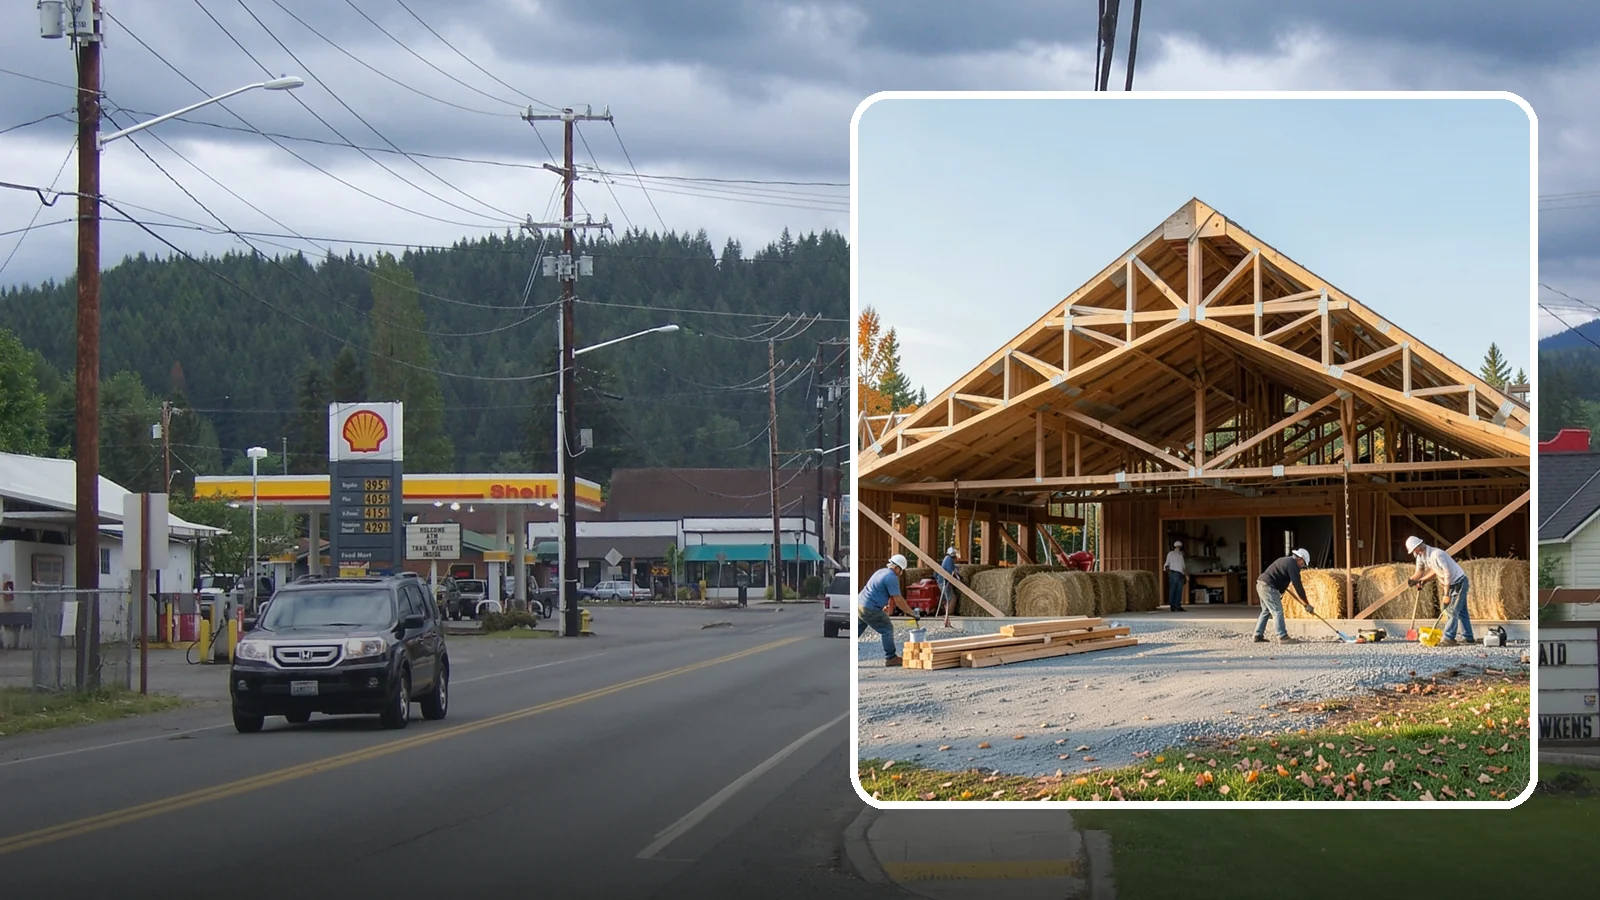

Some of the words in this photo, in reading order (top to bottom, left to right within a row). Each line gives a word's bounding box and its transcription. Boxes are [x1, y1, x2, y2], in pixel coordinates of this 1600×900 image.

[365, 480, 383, 490] 395
[490, 484, 548, 499] Shell
[365, 494, 383, 504] 405
[365, 508, 383, 518] 415
[365, 522, 383, 532] 429
